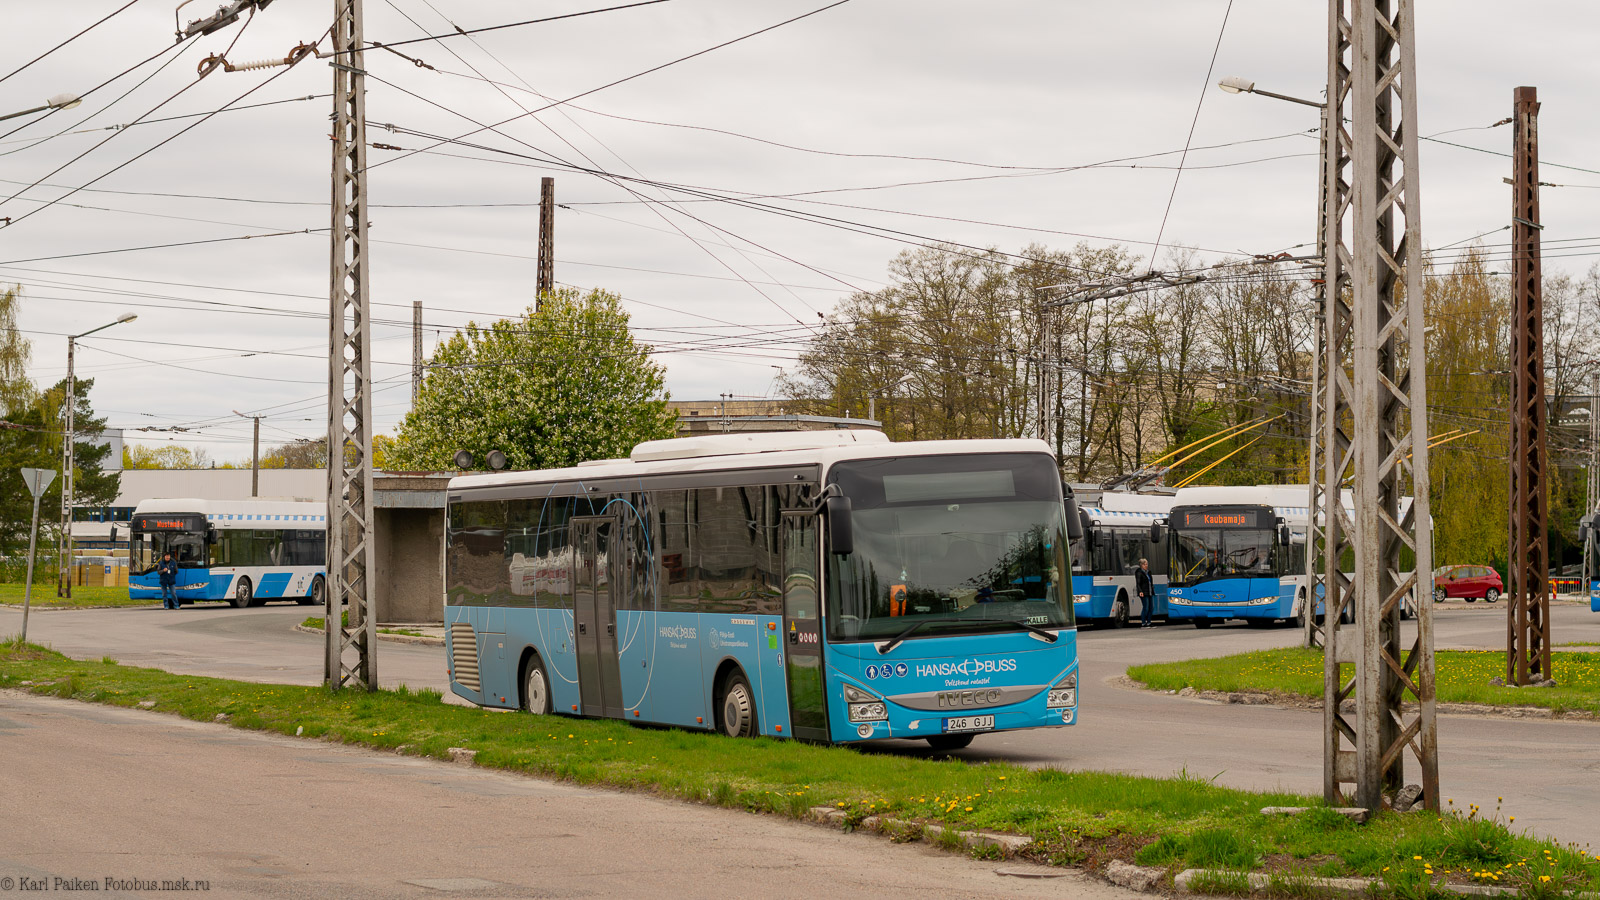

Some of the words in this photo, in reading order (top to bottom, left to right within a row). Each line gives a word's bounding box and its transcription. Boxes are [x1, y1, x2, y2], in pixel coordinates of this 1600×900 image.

[142, 519, 147, 529] 3
[1185, 514, 1190, 526] 1
[1204, 514, 1246, 525] Kaubamaja
[1170, 588, 1183, 596] 450
[1027, 616, 1048, 625] KALLE
[916, 662, 959, 678] HANSA
[984, 658, 1017, 673] BUSS
[938, 689, 1001, 708] IVECO
[950, 718, 967, 729] 246
[973, 716, 992, 727] GJJ
